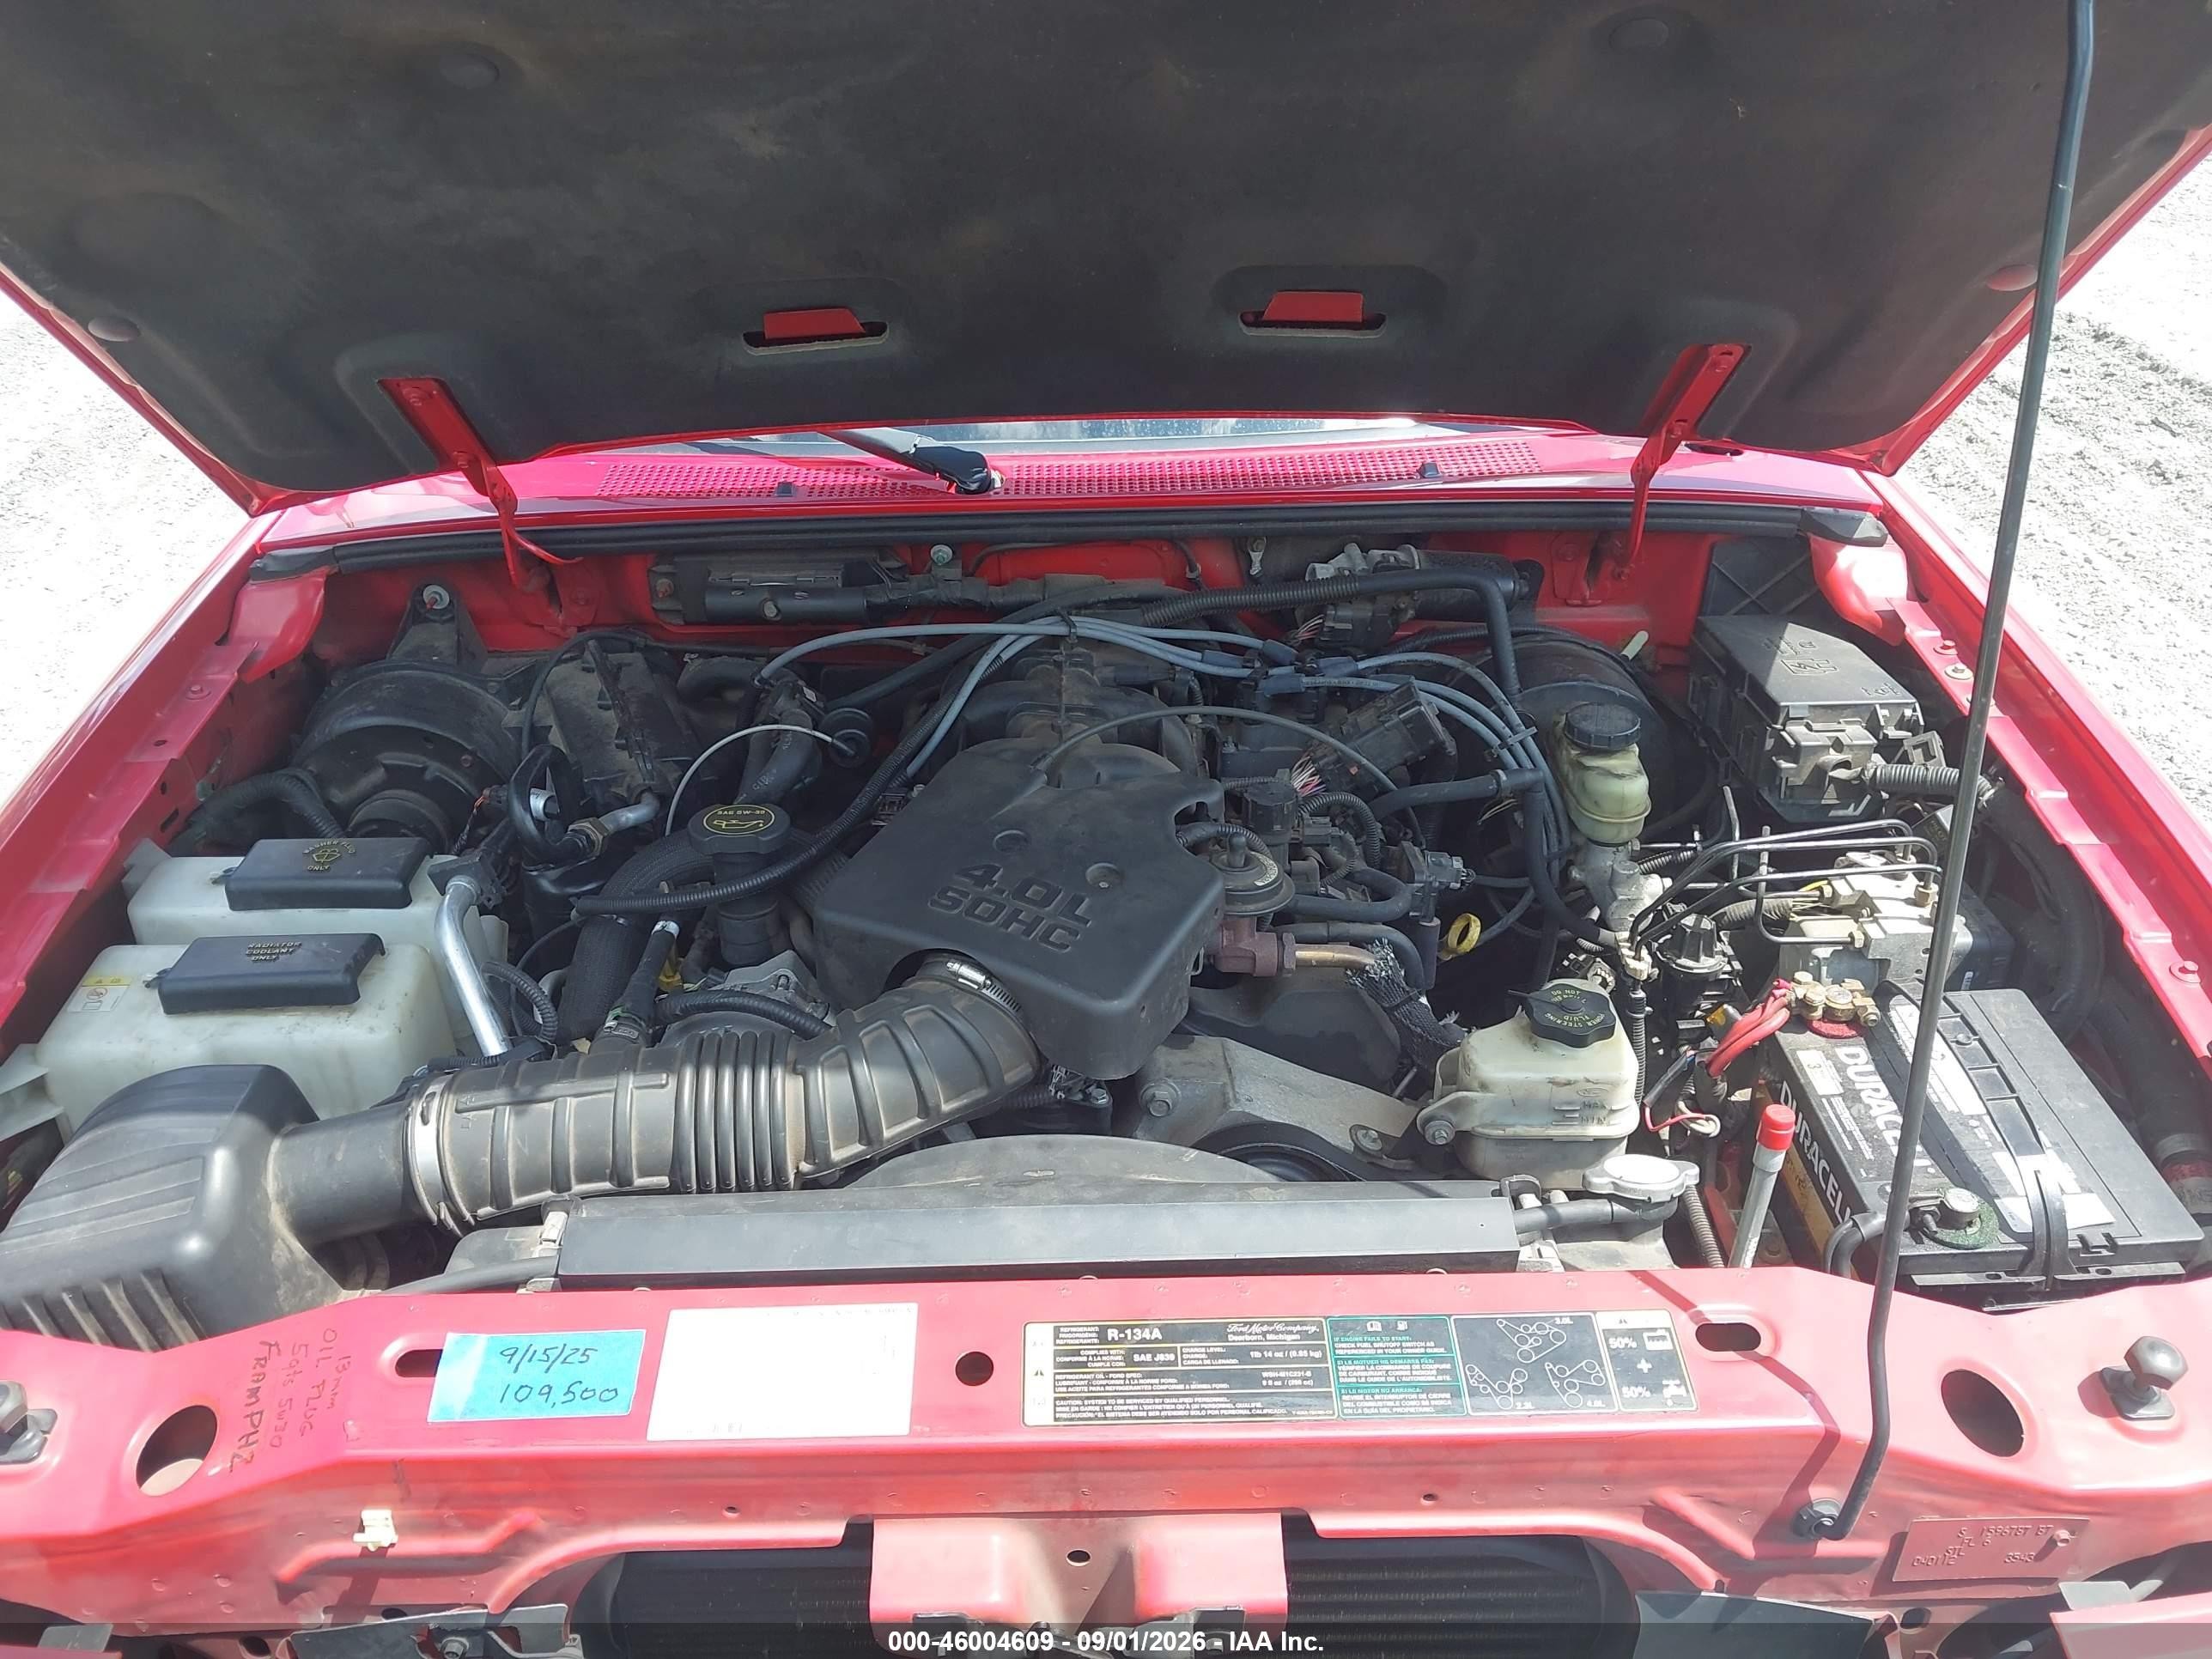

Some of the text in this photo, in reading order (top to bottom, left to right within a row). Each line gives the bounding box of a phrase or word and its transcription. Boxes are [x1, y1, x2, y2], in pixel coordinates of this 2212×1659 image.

[953, 862, 1092, 927] 4.0L
[927, 885, 1081, 953] SOHC
[1544, 1012, 1583, 1028] STEERING
[1107, 1328, 1162, 1341] R-134A
[1226, 1323, 1249, 1333] Ford
[1249, 1323, 1274, 1334] Motor
[1267, 1333, 1300, 1341] Michigan
[1608, 1337, 1637, 1348] 50%
[316, 1328, 337, 1368] OIL
[500, 1343, 598, 1374] 9/15/25
[500, 1380, 618, 1408] 109,500
[1622, 1387, 1650, 1398] 50%
